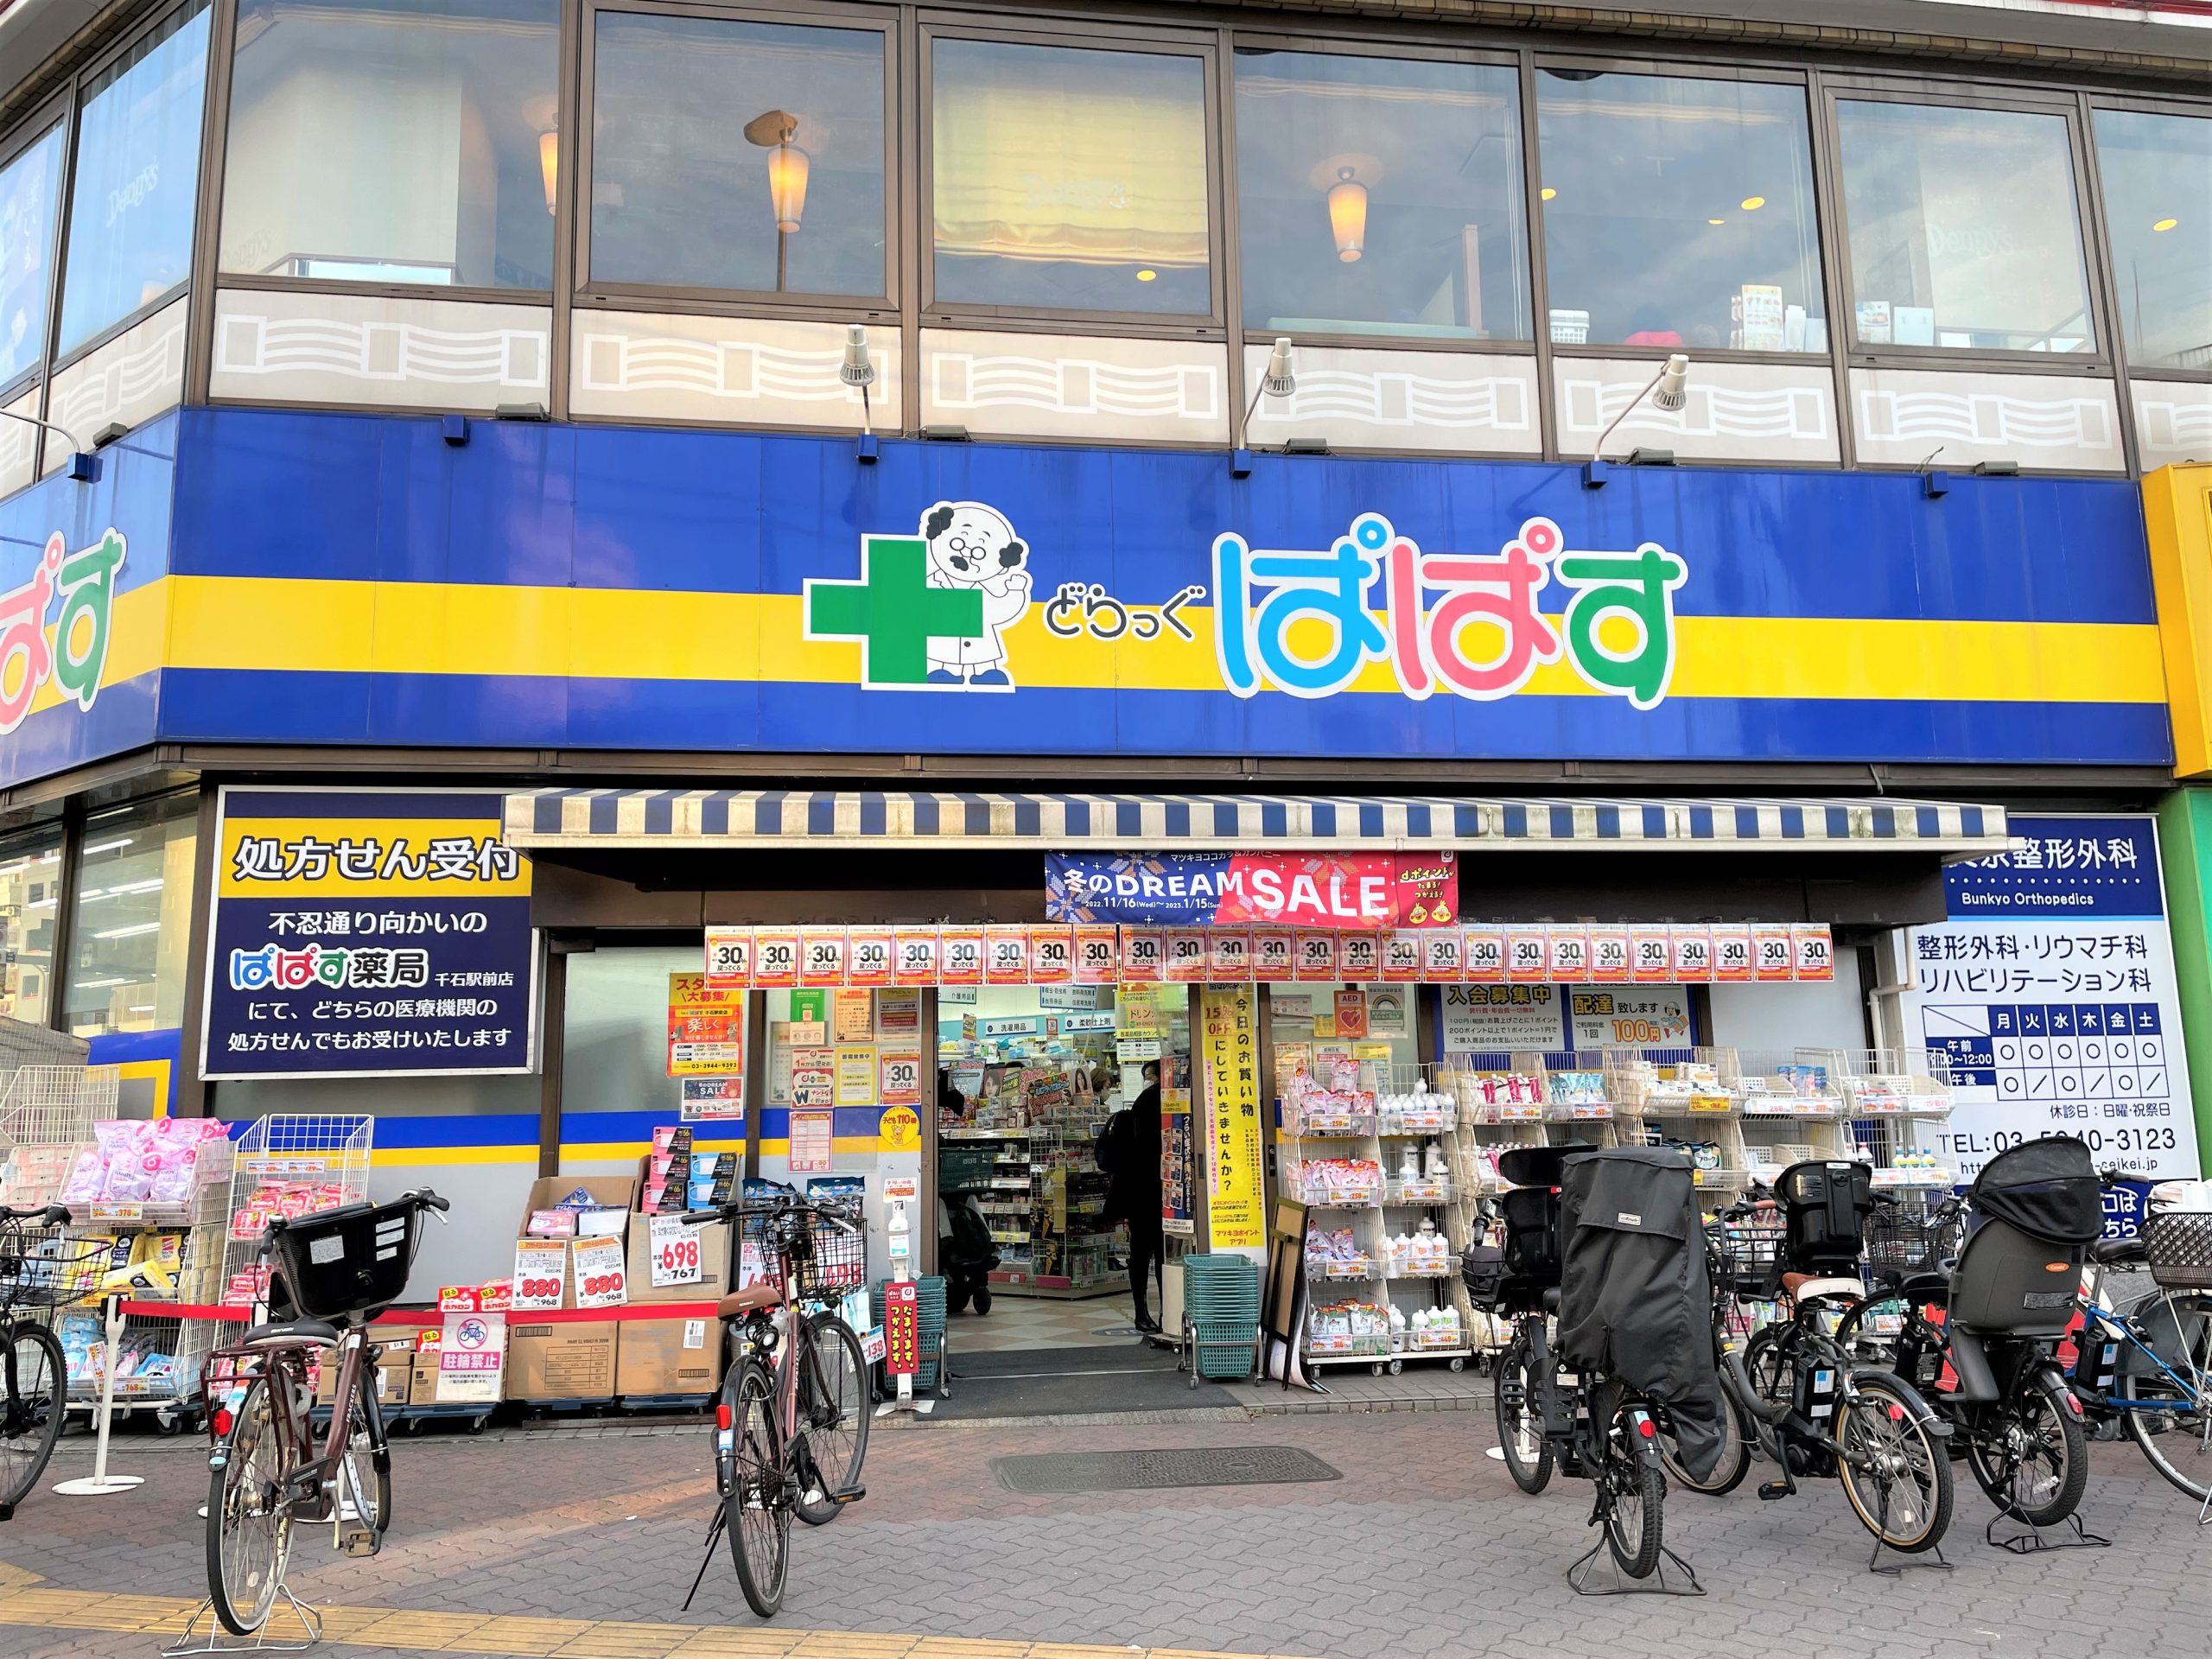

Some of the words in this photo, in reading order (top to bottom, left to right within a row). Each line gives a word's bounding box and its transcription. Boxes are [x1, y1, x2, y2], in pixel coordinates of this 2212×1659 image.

[1045, 583, 1206, 639] どらっぐ
[1213, 512, 1688, 709] ぱぱす
[233, 836, 518, 880] 処方せん受付
[1252, 868, 1389, 916] SALE
[1961, 893, 2011, 906] Bunkyo
[2015, 893, 2094, 906] Orthopedics
[268, 911, 487, 935] 不忍通り向かいの
[232, 944, 429, 989] ぱぱす薬局
[435, 972, 514, 987] 千石駅前店
[1921, 968, 2152, 993] リハビリテーション科
[688, 991, 724, 1001] 大募集
[1447, 985, 1551, 1005] 入会募集中
[1573, 994, 1614, 1015] 配達
[1618, 1002, 1658, 1014] 致します
[248, 999, 498, 1020] にて、どちらの医療機関の
[687, 1018, 719, 1033] 楽しく
[1001, 1023, 1027, 1032] 洗濯用品
[1997, 1014, 2011, 1029] 月
[2025, 1013, 2040, 1028] 火
[2054, 1013, 2069, 1028] 水
[2082, 1013, 2097, 1027] 木
[2111, 1012, 2126, 1027] 金
[2139, 1012, 2154, 1027] 土
[1584, 1029, 1599, 1038] 1回
[1612, 1019, 1661, 1042] 100円
[227, 1029, 512, 1052] 処方せんでもお受けいたします
[1947, 1039, 1972, 1052] 午前
[1236, 998, 1254, 1116] 今日のお買い物
[1951, 1073, 1976, 1085] 午後
[2101, 1193, 2137, 1212] 口は
[2103, 1219, 2137, 1238] ちら
[663, 1241, 698, 1269] 698
[671, 1268, 696, 1279] 767
[522, 1278, 561, 1297] 880
[583, 1272, 623, 1295] 880
[890, 1306, 902, 1369] つかえます。
[903, 1306, 914, 1369] たまります。
[868, 1340, 883, 1357] 138
[442, 1353, 498, 1369] 駐輪禁止
